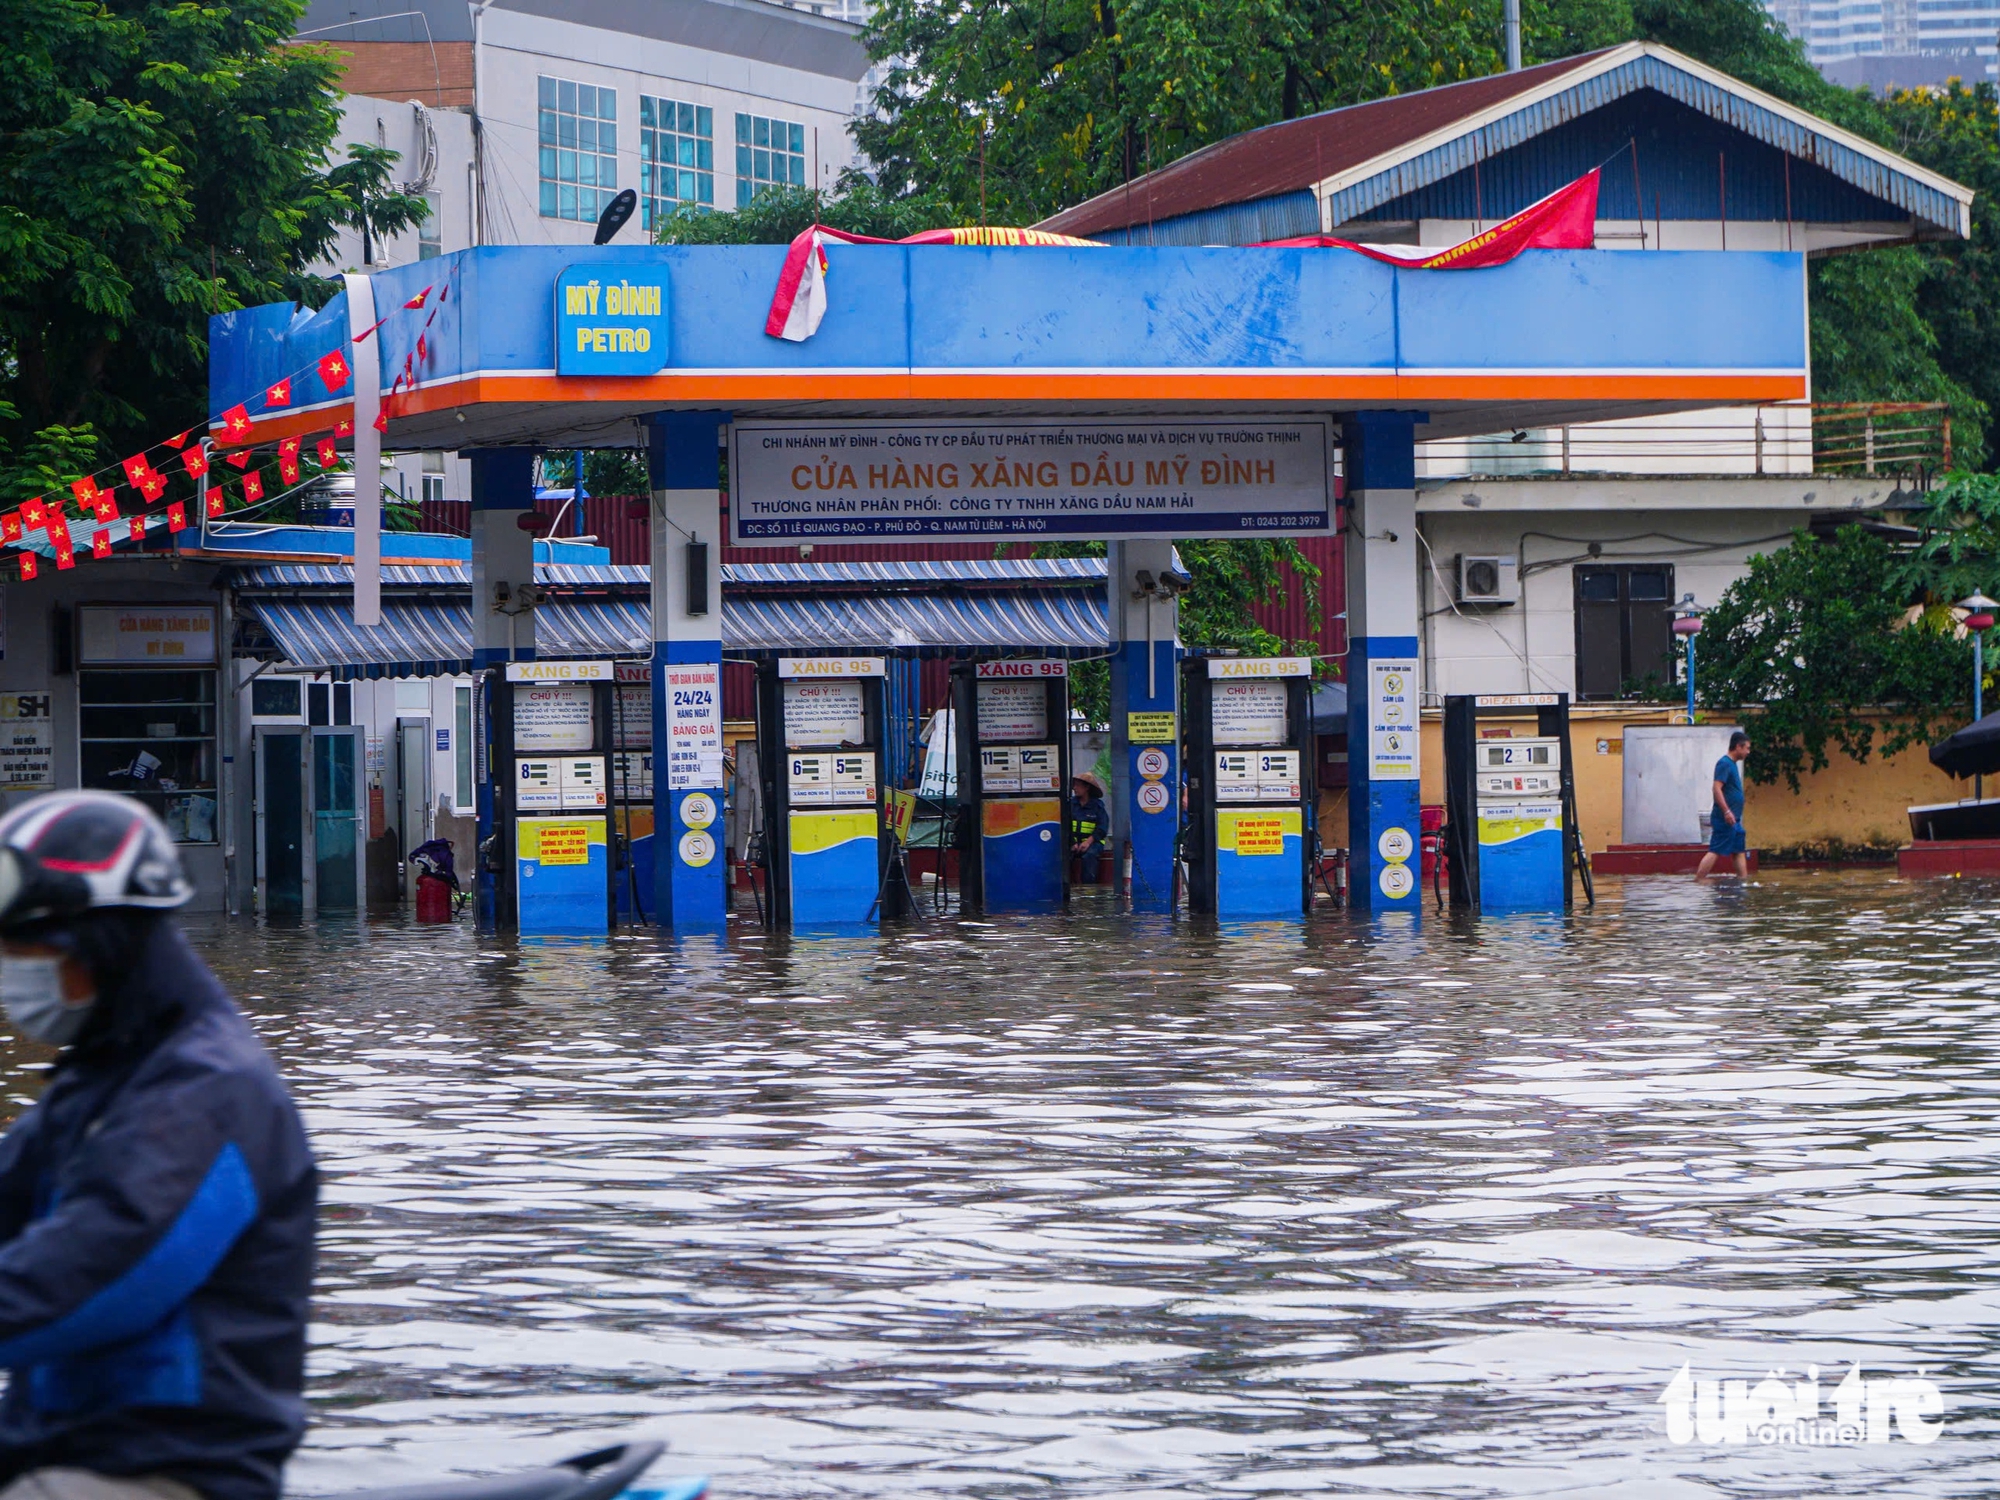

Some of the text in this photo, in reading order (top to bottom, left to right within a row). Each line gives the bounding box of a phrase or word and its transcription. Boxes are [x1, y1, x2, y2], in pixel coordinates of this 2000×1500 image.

[566, 279, 661, 315] MỸ ĐÌNH
[577, 328, 651, 353] PETRO
[762, 429, 1301, 448] CHI NHÁNH MỸ ĐÌNH CÔNG TY CP ĐẦU TƯ PHÁT TRIỂN THƯƠNG MẠI VÀ DỊCH VỤ TRƯỜNG THỊNH
[790, 451, 1276, 491] CỬA HÀNG XĂNG DẦU MỸ ĐÌNH
[751, 491, 1193, 514] THƯƠNG NHÂN PHÂN PHỐI: CÔNG TY TNHH XĂNG DẦU NAM HẢI
[747, 524, 764, 534] ĐC:
[767, 521, 781, 534] SỐ
[791, 521, 801, 533] LÊ
[803, 522, 840, 533] QUANG
[843, 522, 865, 535] ĐẠO
[874, 522, 883, 532] P.
[885, 519, 904, 532] PHÚ
[906, 519, 921, 531] ĐÔ
[930, 521, 941, 532] Q.
[944, 521, 965, 531] NAM
[968, 518, 980, 531] TỪ
[982, 519, 1003, 530] LIÊM
[1011, 518, 1024, 530] HÀ
[1028, 519, 1046, 531] NỘI
[1240, 516, 1320, 527] ĐT: 0243 202 3979
[519, 664, 600, 678] XĂNG 95
[792, 660, 872, 674] XĂNG 95
[978, 661, 1064, 676] XĂNG 95
[1221, 661, 1299, 676] XĂNG 95
[530, 690, 551, 700] CHÚ
[553, 690, 560, 700] Ý
[674, 690, 713, 706] 24/24
[1480, 697, 1525, 706] DIEZEL
[981, 751, 993, 765] 11
[1020, 750, 1033, 764] 12
[1505, 748, 1513, 763] 2
[1526, 748, 1532, 762] 1
[521, 763, 530, 779] 8
[793, 760, 802, 775] 6
[836, 759, 845, 774] 5
[1219, 756, 1228, 771] 4
[1262, 756, 1270, 771] 3
